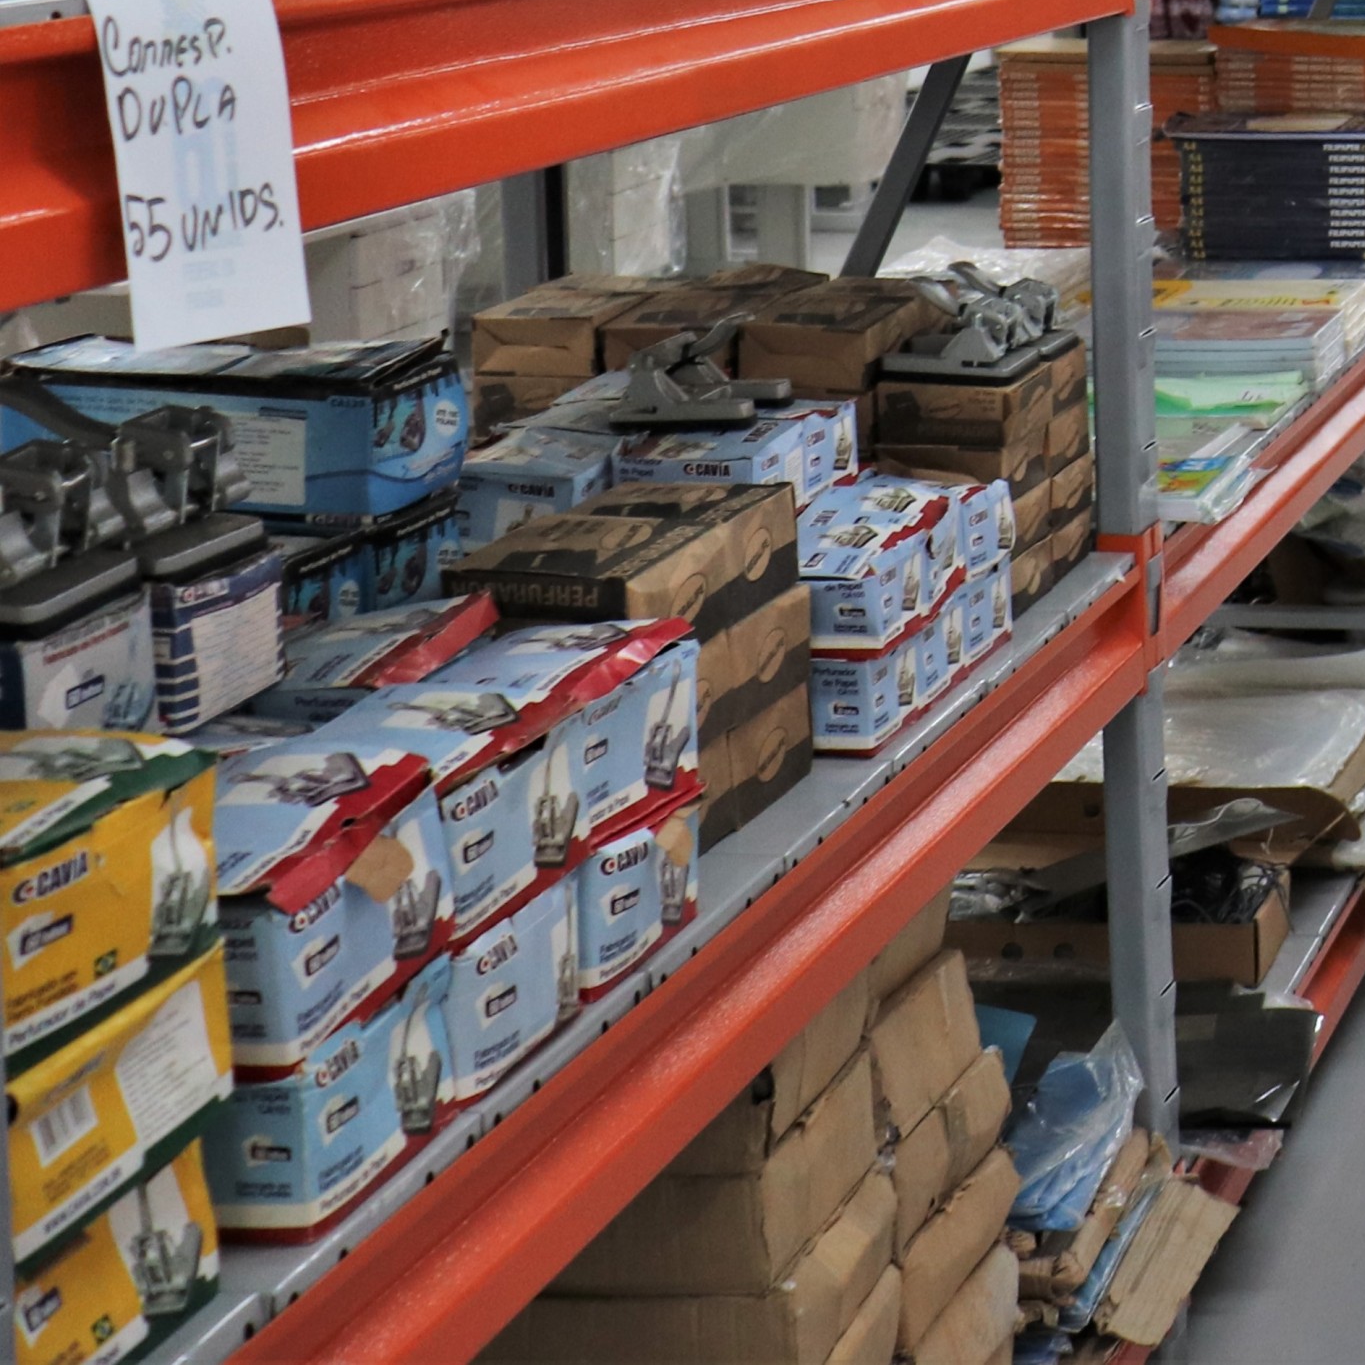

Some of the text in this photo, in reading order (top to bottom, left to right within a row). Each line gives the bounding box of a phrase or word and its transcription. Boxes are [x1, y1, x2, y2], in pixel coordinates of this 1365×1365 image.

[117, 75, 238, 142] DUPLA
[124, 194, 173, 263] 55
[37, 851, 88, 898] CAVIA
